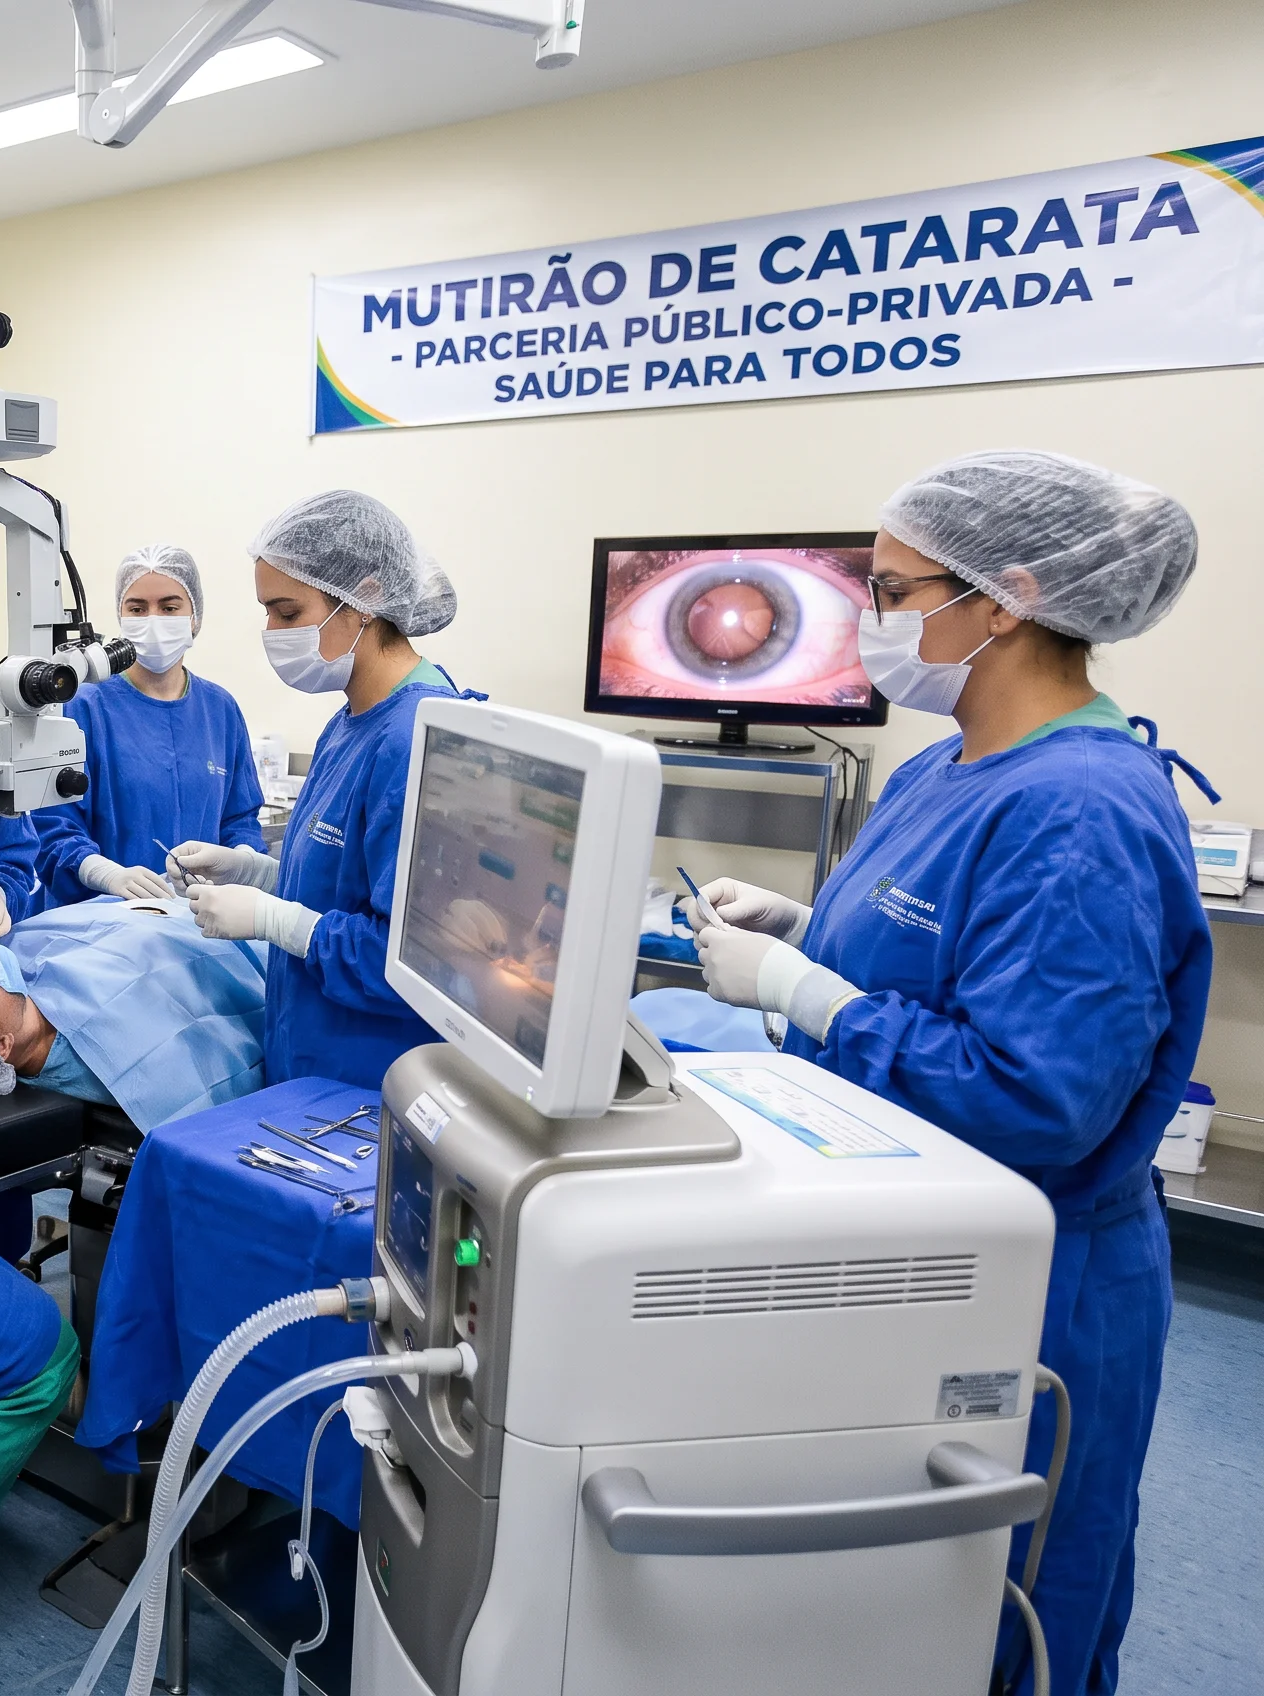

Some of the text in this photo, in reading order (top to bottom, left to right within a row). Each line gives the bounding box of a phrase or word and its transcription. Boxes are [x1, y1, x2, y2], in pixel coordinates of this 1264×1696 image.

[363, 180, 1200, 334] MUTIRÃO DE CATARATA
[415, 321, 609, 369] PARCERIA
[623, 266, 1094, 348] PÚBLICO-PRIVADA
[493, 332, 962, 404] SAÚDE PARA TODOS
